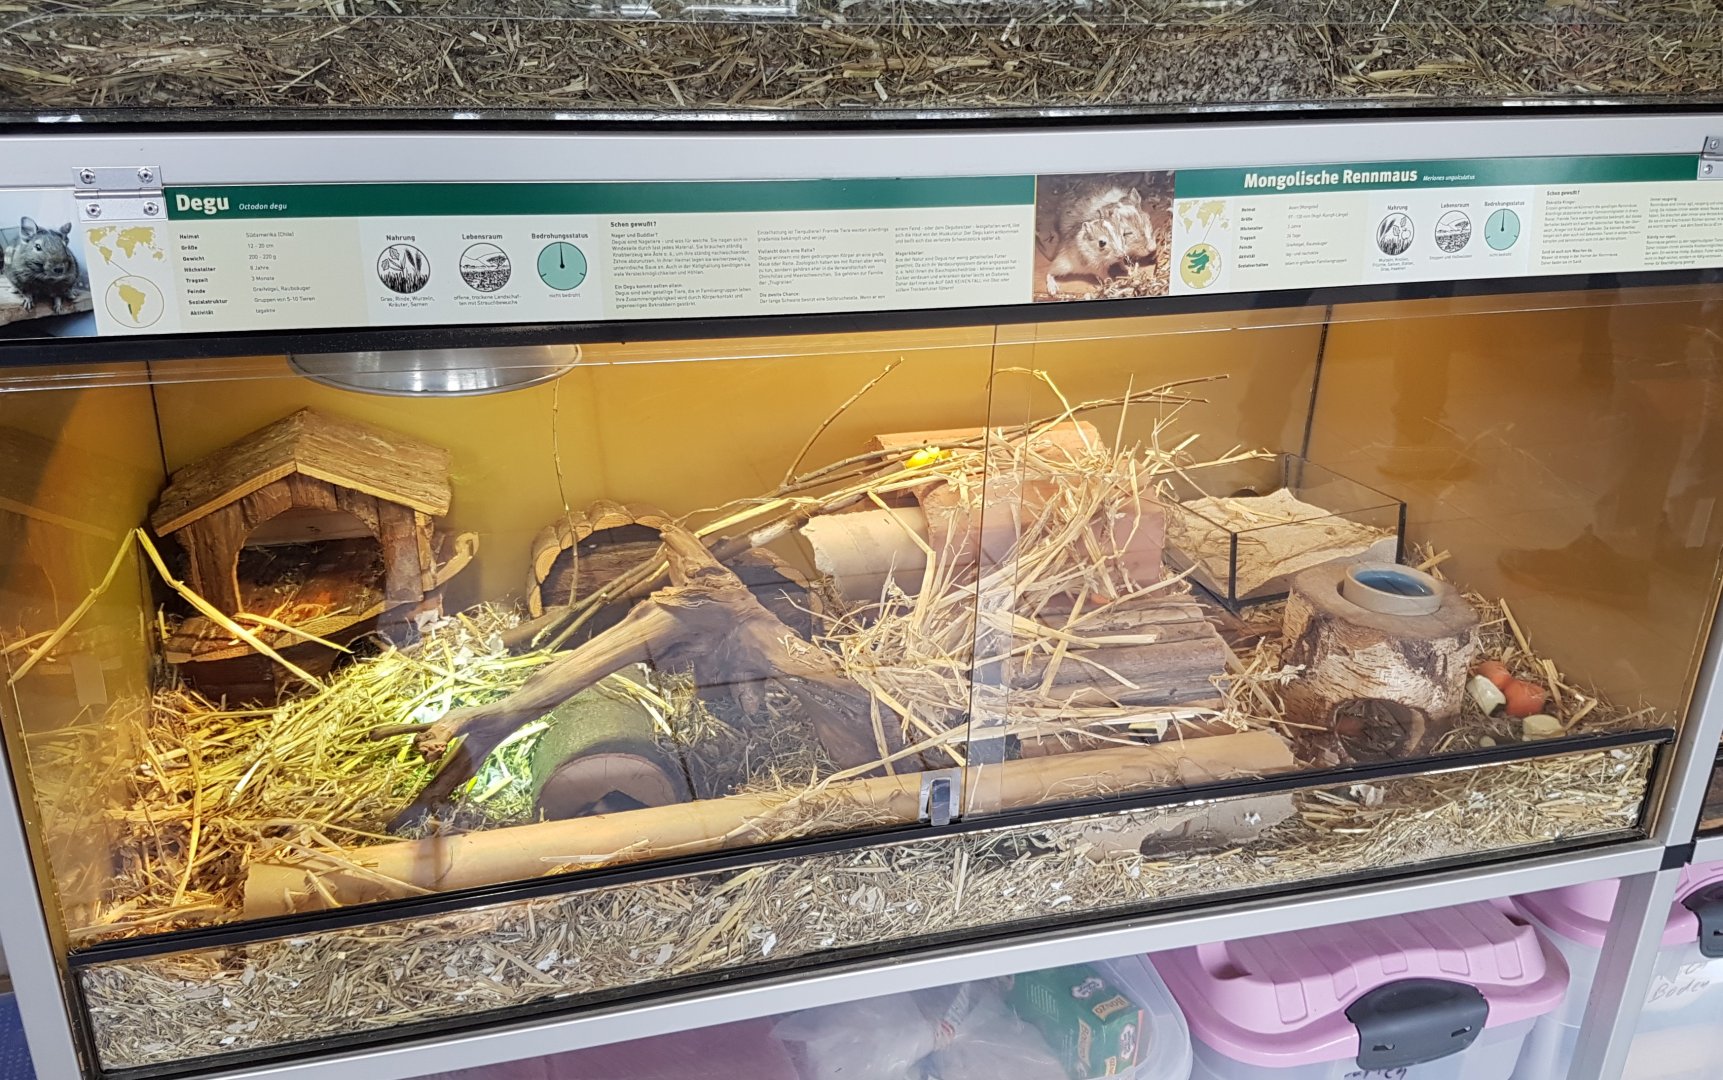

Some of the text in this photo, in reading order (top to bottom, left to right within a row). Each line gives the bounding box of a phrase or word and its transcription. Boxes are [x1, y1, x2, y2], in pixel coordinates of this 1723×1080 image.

[1244, 169, 1417, 190] Mongolische Rennmaus
[176, 194, 229, 214] Degu
[270, 203, 287, 212] degu
